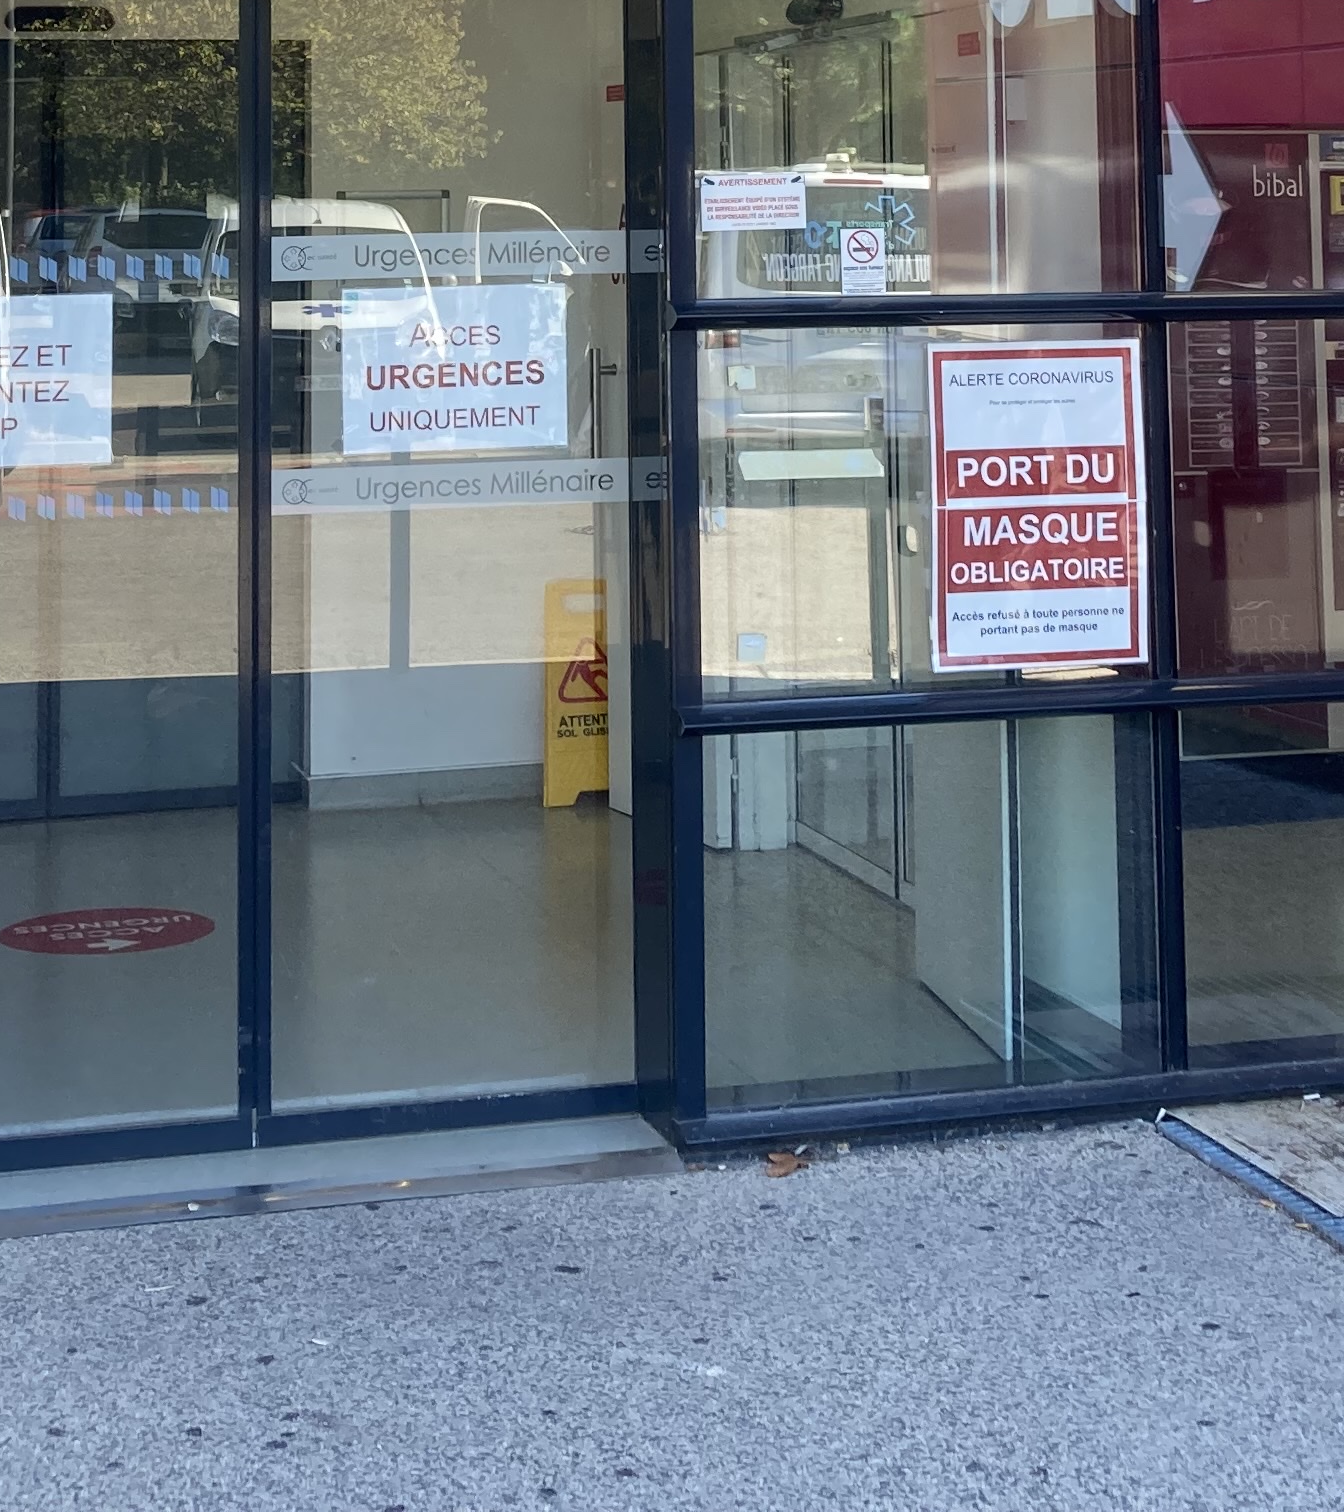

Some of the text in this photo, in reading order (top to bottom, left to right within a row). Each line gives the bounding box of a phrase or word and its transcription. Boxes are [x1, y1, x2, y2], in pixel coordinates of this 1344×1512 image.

[718, 178, 787, 187] AVERTISSEMENT
[1253, 164, 1304, 197] bibal
[354, 240, 611, 272] Urgences Millénaire
[37, 345, 73, 366] ET
[366, 359, 546, 391] URGENCES
[949, 371, 1114, 387] ALERTE CORONAVIRUS
[369, 405, 541, 434] UNIQUEMENT
[957, 452, 1115, 488] PORT DU
[355, 475, 482, 505] Urgences
[490, 470, 614, 494] Millénaire
[963, 511, 1118, 547] MASQUE
[951, 557, 1125, 585] OBLIGATOIRE
[952, 607, 1124, 622] Accès refusé à toute personne ne
[980, 622, 1098, 638] portant pas de masque
[559, 713, 608, 728] ATTENT
